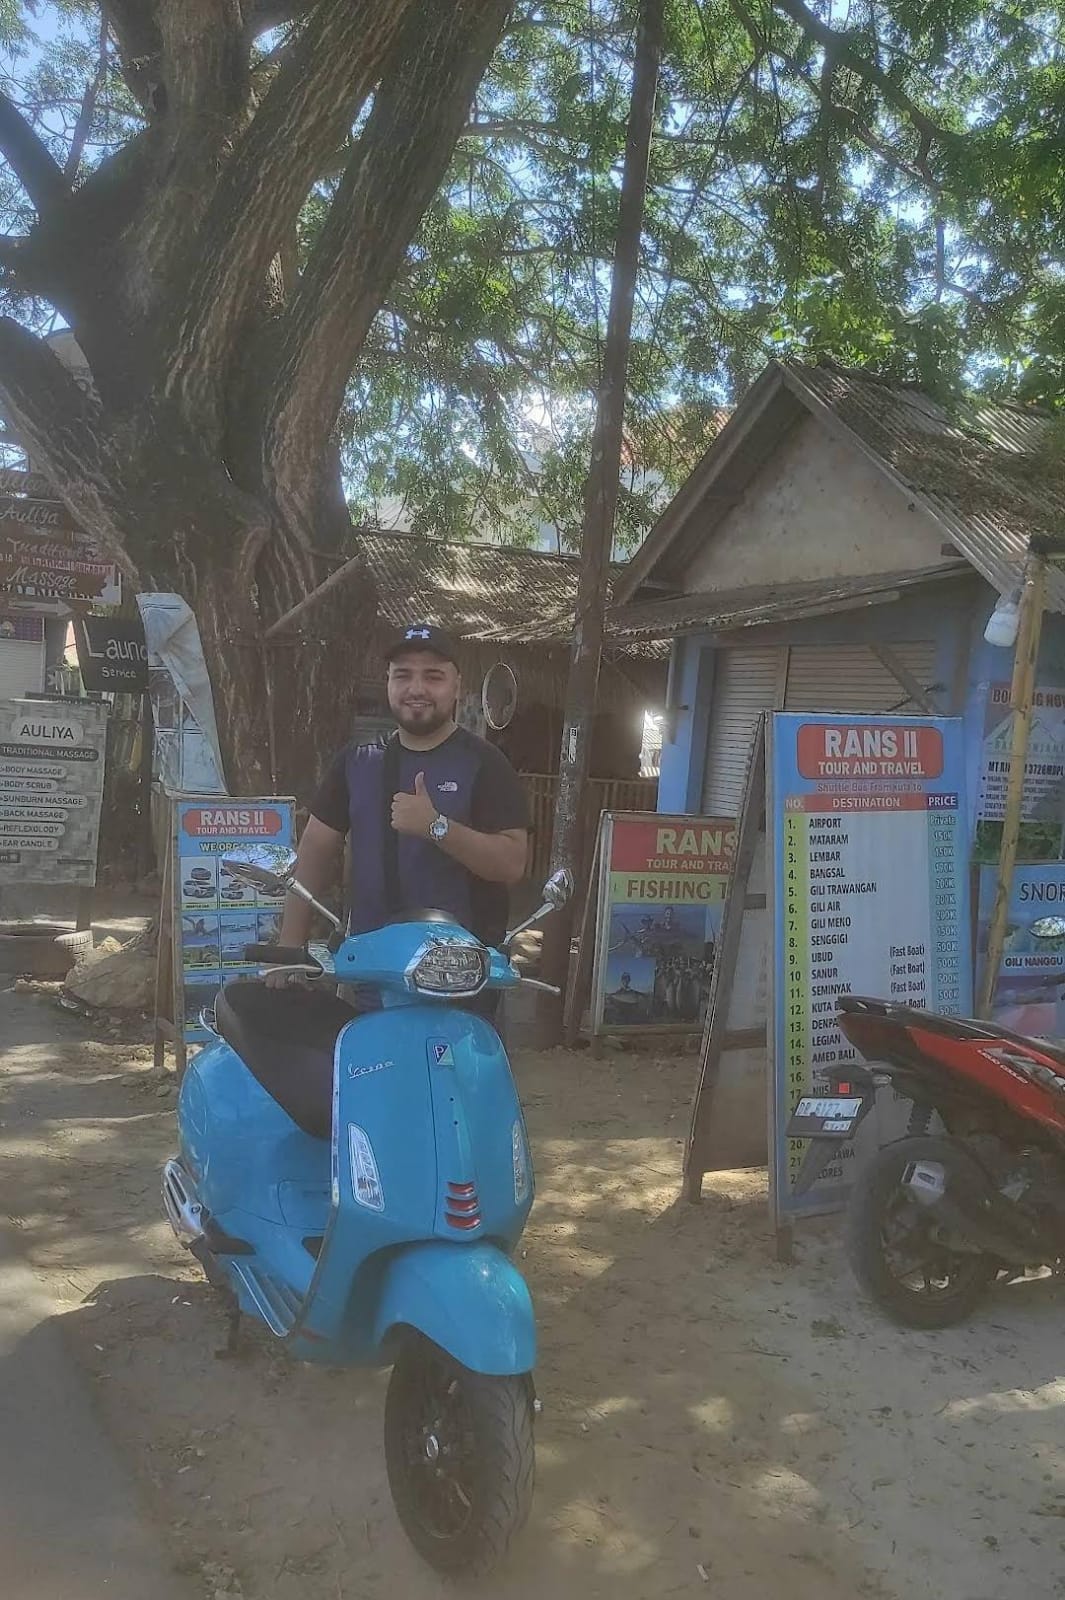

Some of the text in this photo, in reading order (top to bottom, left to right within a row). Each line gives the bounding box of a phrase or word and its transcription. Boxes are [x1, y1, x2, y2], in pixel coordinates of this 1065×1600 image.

[20, 724, 74, 740] AULIYA
[824, 729, 917, 758] RANS II
[3, 746, 97, 759] TRADITIONAL MASSAGE
[27, 767, 62, 776] MASSAGE
[818, 761, 925, 775] TOUR AND TRAVEL
[4, 780, 52, 789] BODY SCRUB
[3, 795, 84, 805] SUNBURN MASSAGE
[833, 797, 900, 808] DESTINATION
[928, 796, 956, 806] PRICE
[4, 809, 25, 817] BACK
[200, 810, 264, 825] RANS II
[4, 824, 59, 833] REFLEXOLOGY
[809, 818, 842, 829] AIRPORT
[20, 840, 52, 848] CANDLE
[656, 828, 738, 856] RANS
[809, 834, 849, 845] MATARAM
[810, 851, 841, 862] LEMBAR
[646, 858, 678, 869] TOUR
[681, 860, 704, 870] AND
[810, 868, 845, 879] BANGSAL
[627, 879, 711, 899] FISHING
[810, 886, 825, 896] GILI
[828, 882, 877, 895] TRAWANGAN
[810, 903, 825, 913] GILI
[827, 901, 841, 911] AIR
[811, 918, 826, 929] GILI
[828, 917, 851, 928] MENO
[811, 934, 848, 946] SENGGIGI
[811, 951, 833, 963] UBUD
[1005, 957, 1022, 967] GILI
[811, 968, 838, 980] SANUR
[811, 983, 852, 996] SEMINYAK
[811, 1001, 832, 1013] KUTA
[812, 1018, 839, 1030] DENPA
[812, 1034, 840, 1046] LEGIAN
[812, 1052, 836, 1063] AMED
[838, 1048, 856, 1060] BALI
